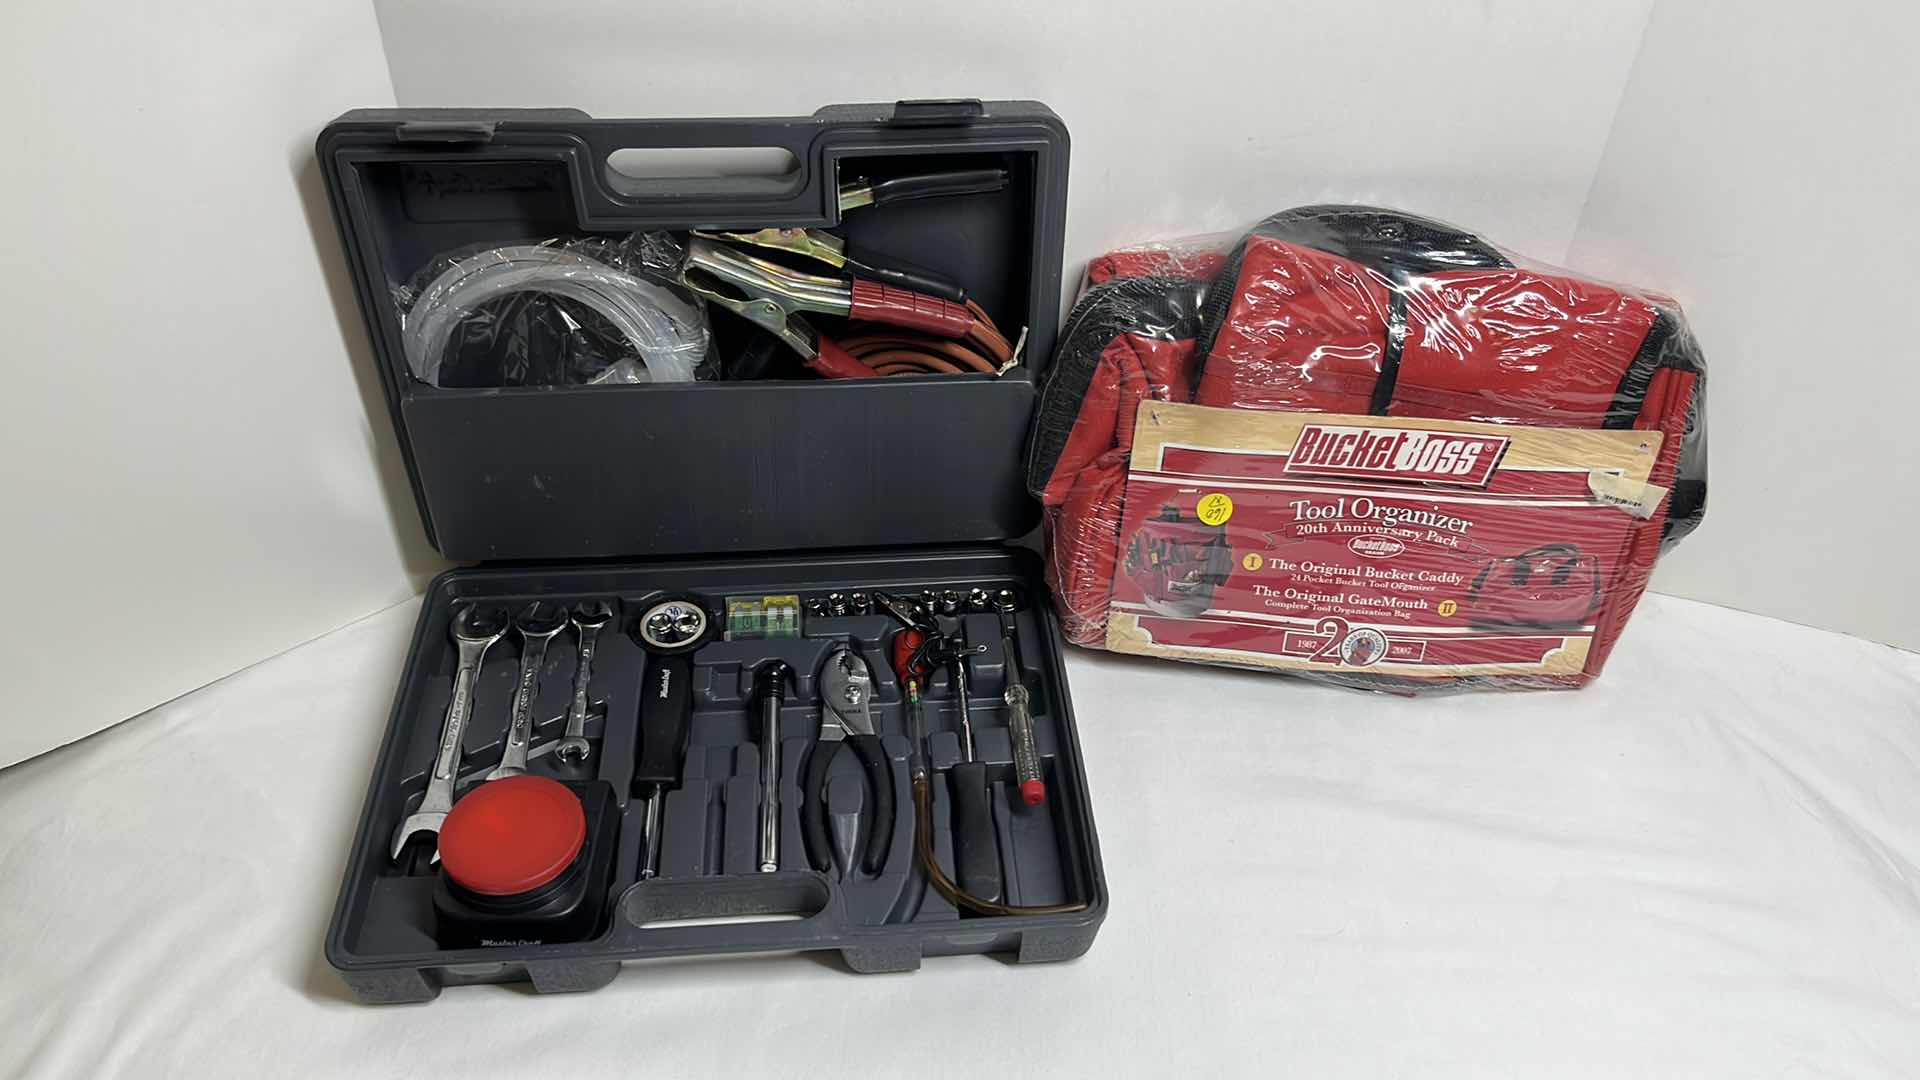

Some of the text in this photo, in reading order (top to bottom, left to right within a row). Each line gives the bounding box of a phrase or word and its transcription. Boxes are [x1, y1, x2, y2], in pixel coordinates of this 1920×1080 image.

[1289, 497, 1474, 534] Tool Organizer
[1296, 522, 1460, 548] 20th Anniversary Pack
[1269, 558, 1464, 586] The Original Bucket Caddy
[1303, 574, 1333, 584] Pocket
[1335, 577, 1367, 587] Bucket
[1368, 579, 1389, 589] Tool
[1390, 581, 1436, 591] Organizer
[1253, 584, 1429, 609] The Original GateMouth
[1264, 599, 1412, 619] Complete Tool Organization Bag
[1297, 639, 1317, 649] 1987
